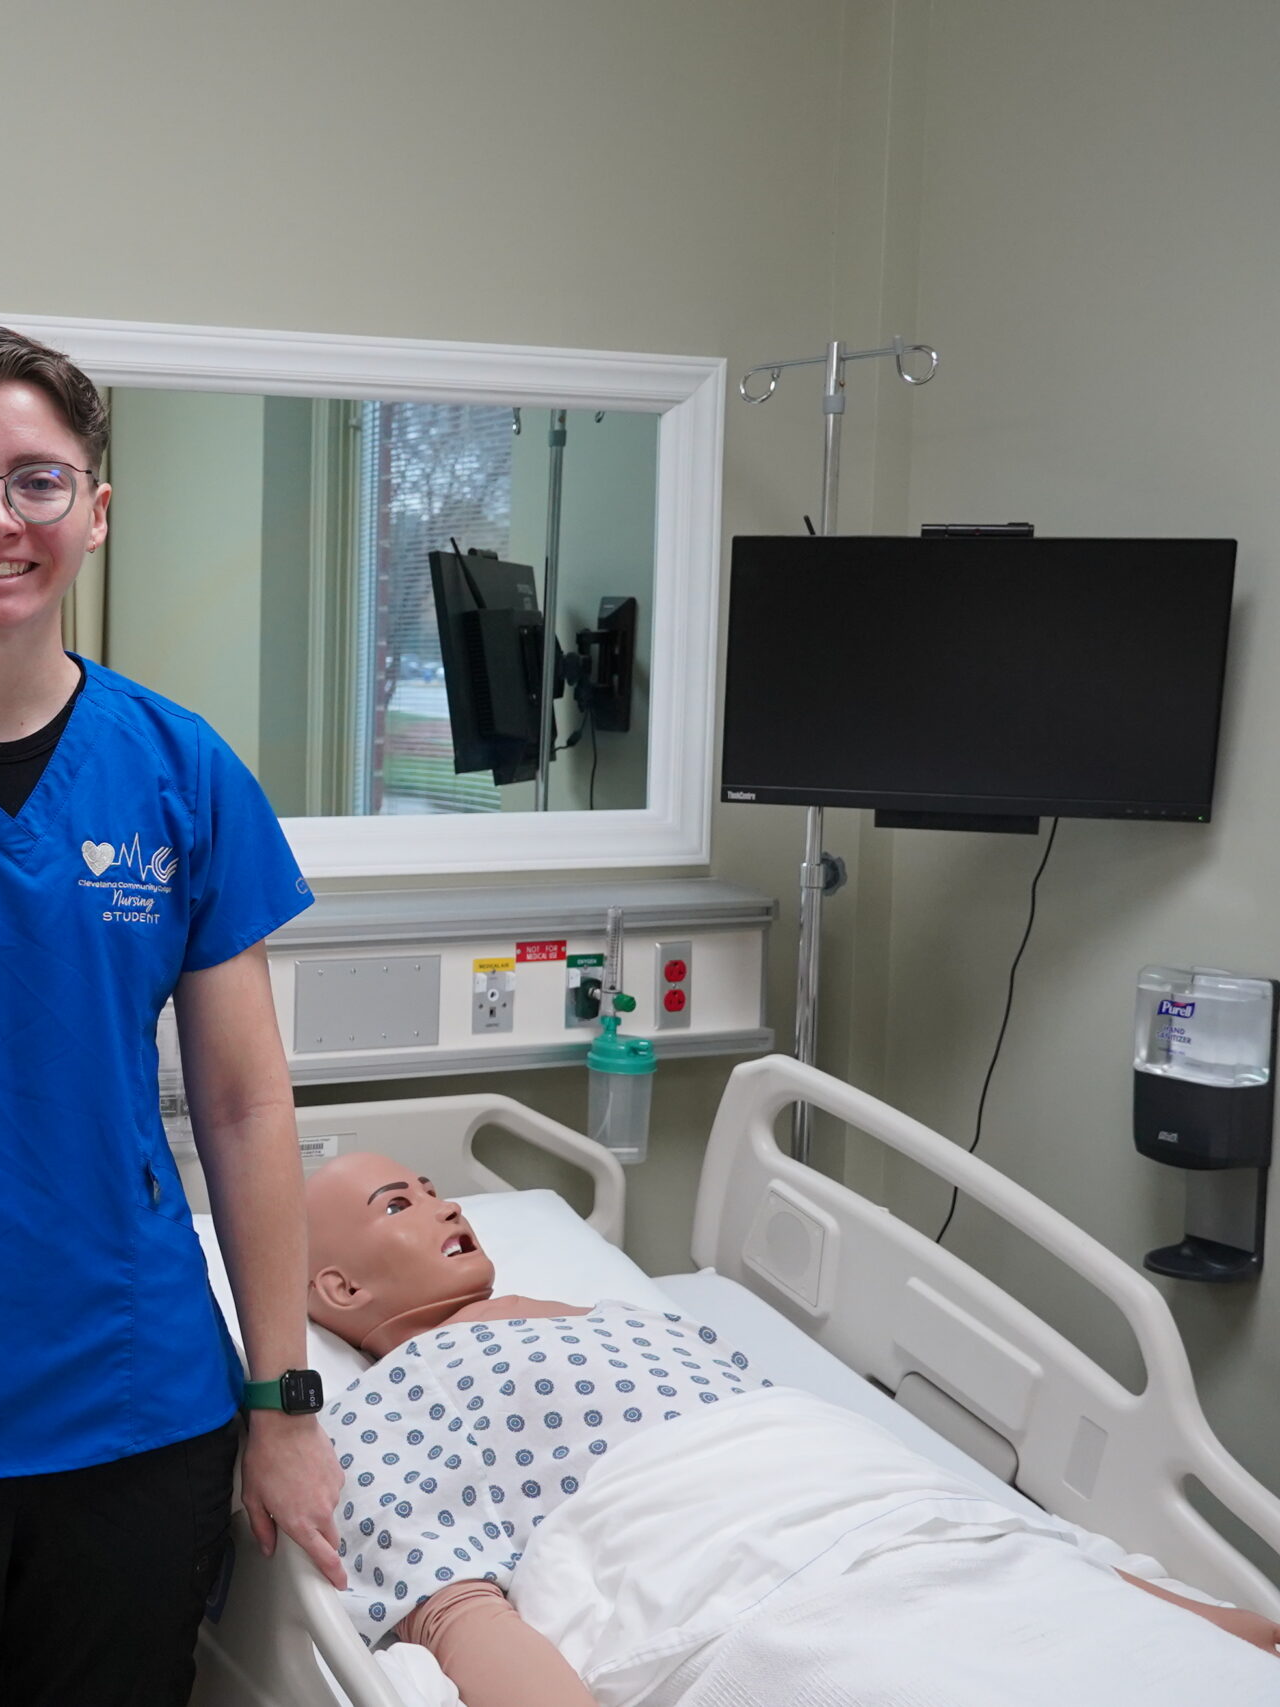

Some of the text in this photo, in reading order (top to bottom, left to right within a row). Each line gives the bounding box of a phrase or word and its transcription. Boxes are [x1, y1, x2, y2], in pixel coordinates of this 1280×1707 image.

[78, 880, 118, 888] Cleveland
[118, 882, 158, 893] Community
[112, 888, 155, 912] Nursing
[102, 911, 160, 924] STUDENT
[526, 952, 547, 960] MEDICAL
